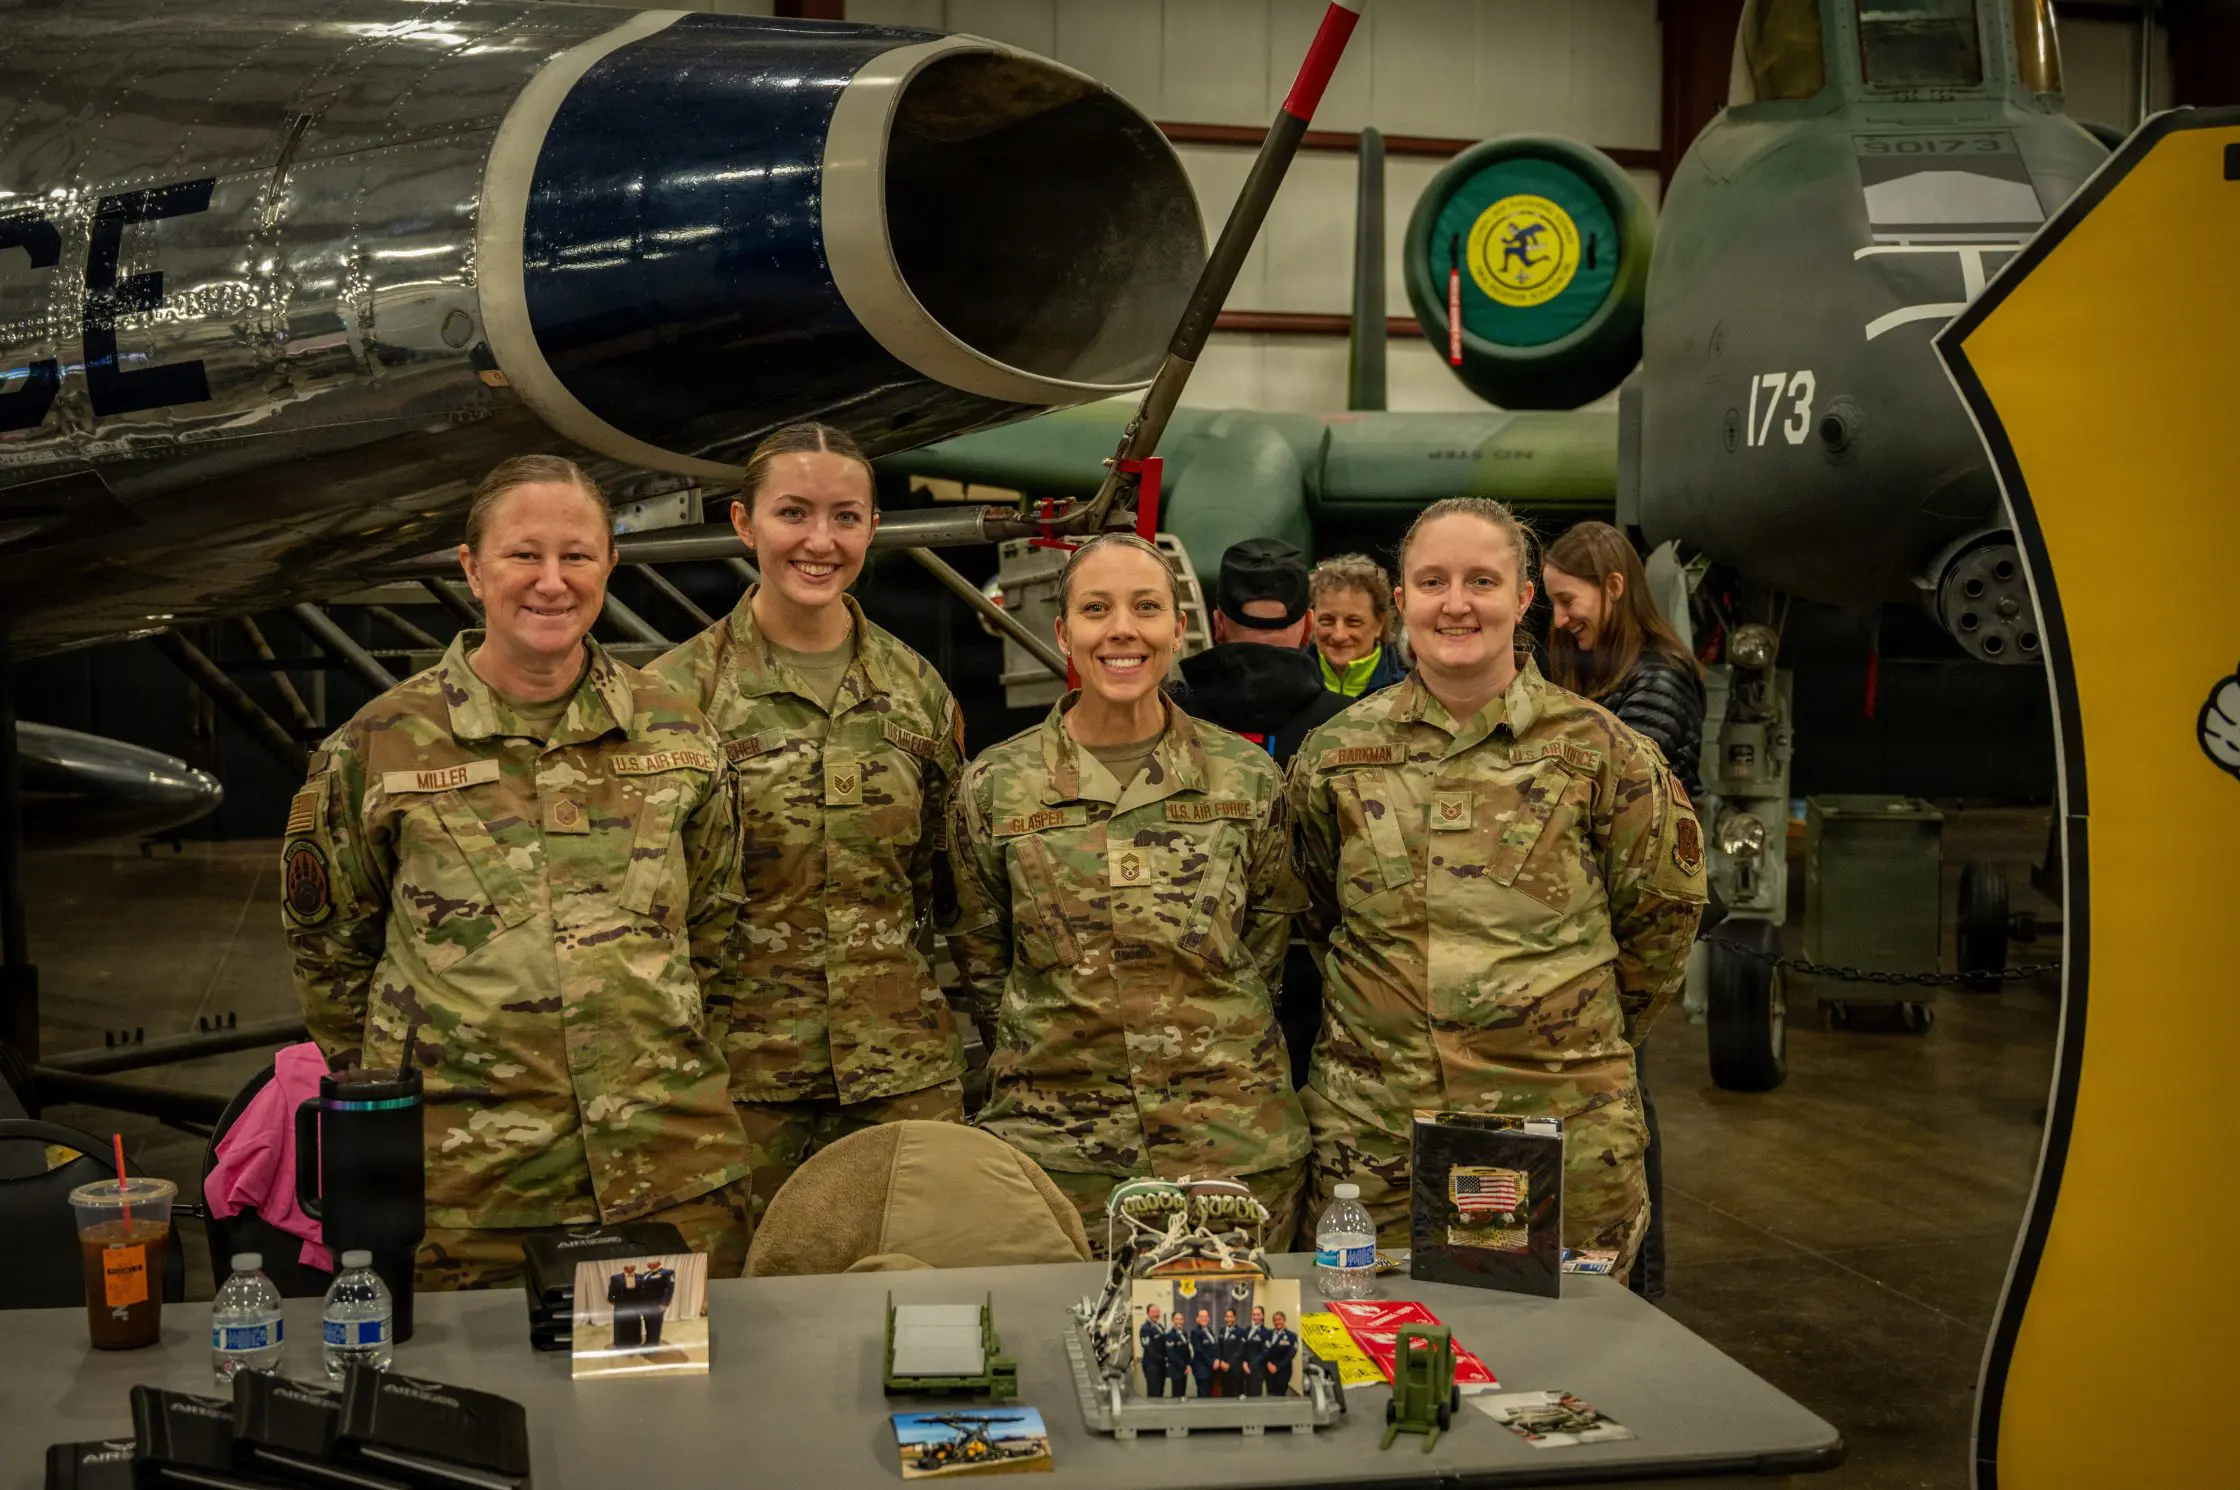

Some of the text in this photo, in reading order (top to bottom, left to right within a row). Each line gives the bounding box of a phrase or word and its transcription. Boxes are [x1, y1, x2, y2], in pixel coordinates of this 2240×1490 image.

[1747, 369, 1816, 447] 173
[646, 753, 670, 771] AIR
[670, 751, 712, 770] FORCE
[416, 767, 468, 790] MILLER
[1012, 809, 1065, 833] GLASPER
[1193, 804, 1212, 820] AIR
